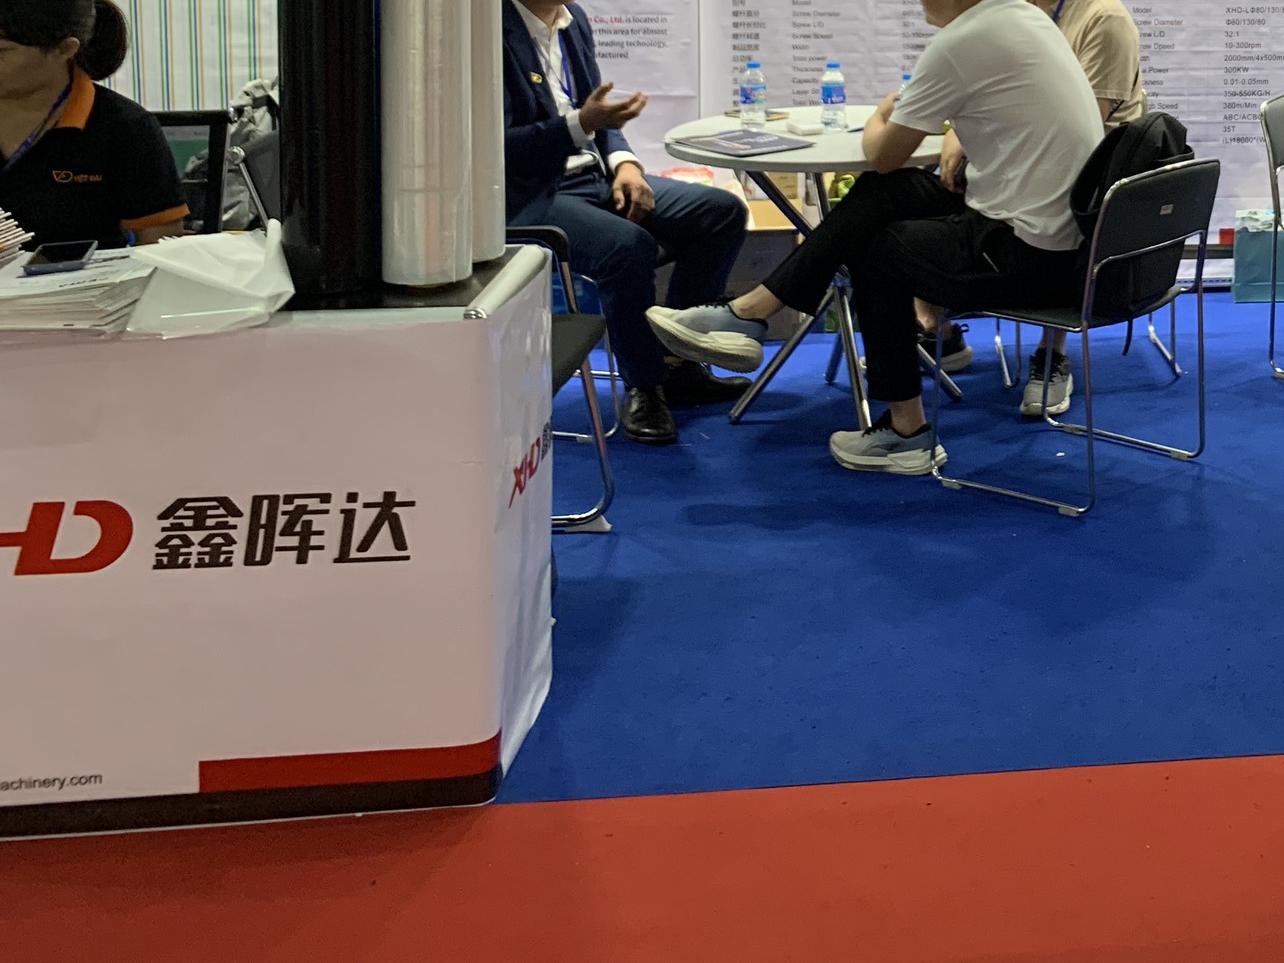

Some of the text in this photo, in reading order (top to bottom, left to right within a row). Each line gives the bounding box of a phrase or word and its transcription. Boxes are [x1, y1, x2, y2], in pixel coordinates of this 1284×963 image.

[1132, 6, 1152, 14] Model
[632, 16, 659, 24] located
[1154, 18, 1183, 26] Diameter
[1225, 42, 1261, 50] 10-300rpm
[1223, 66, 1249, 74] 300KW
[1158, 102, 1178, 111] Speed
[1222, 125, 1236, 133] 35T
[153, 491, 416, 570] 鑫晖达
[0, 774, 103, 791] achinery.com
